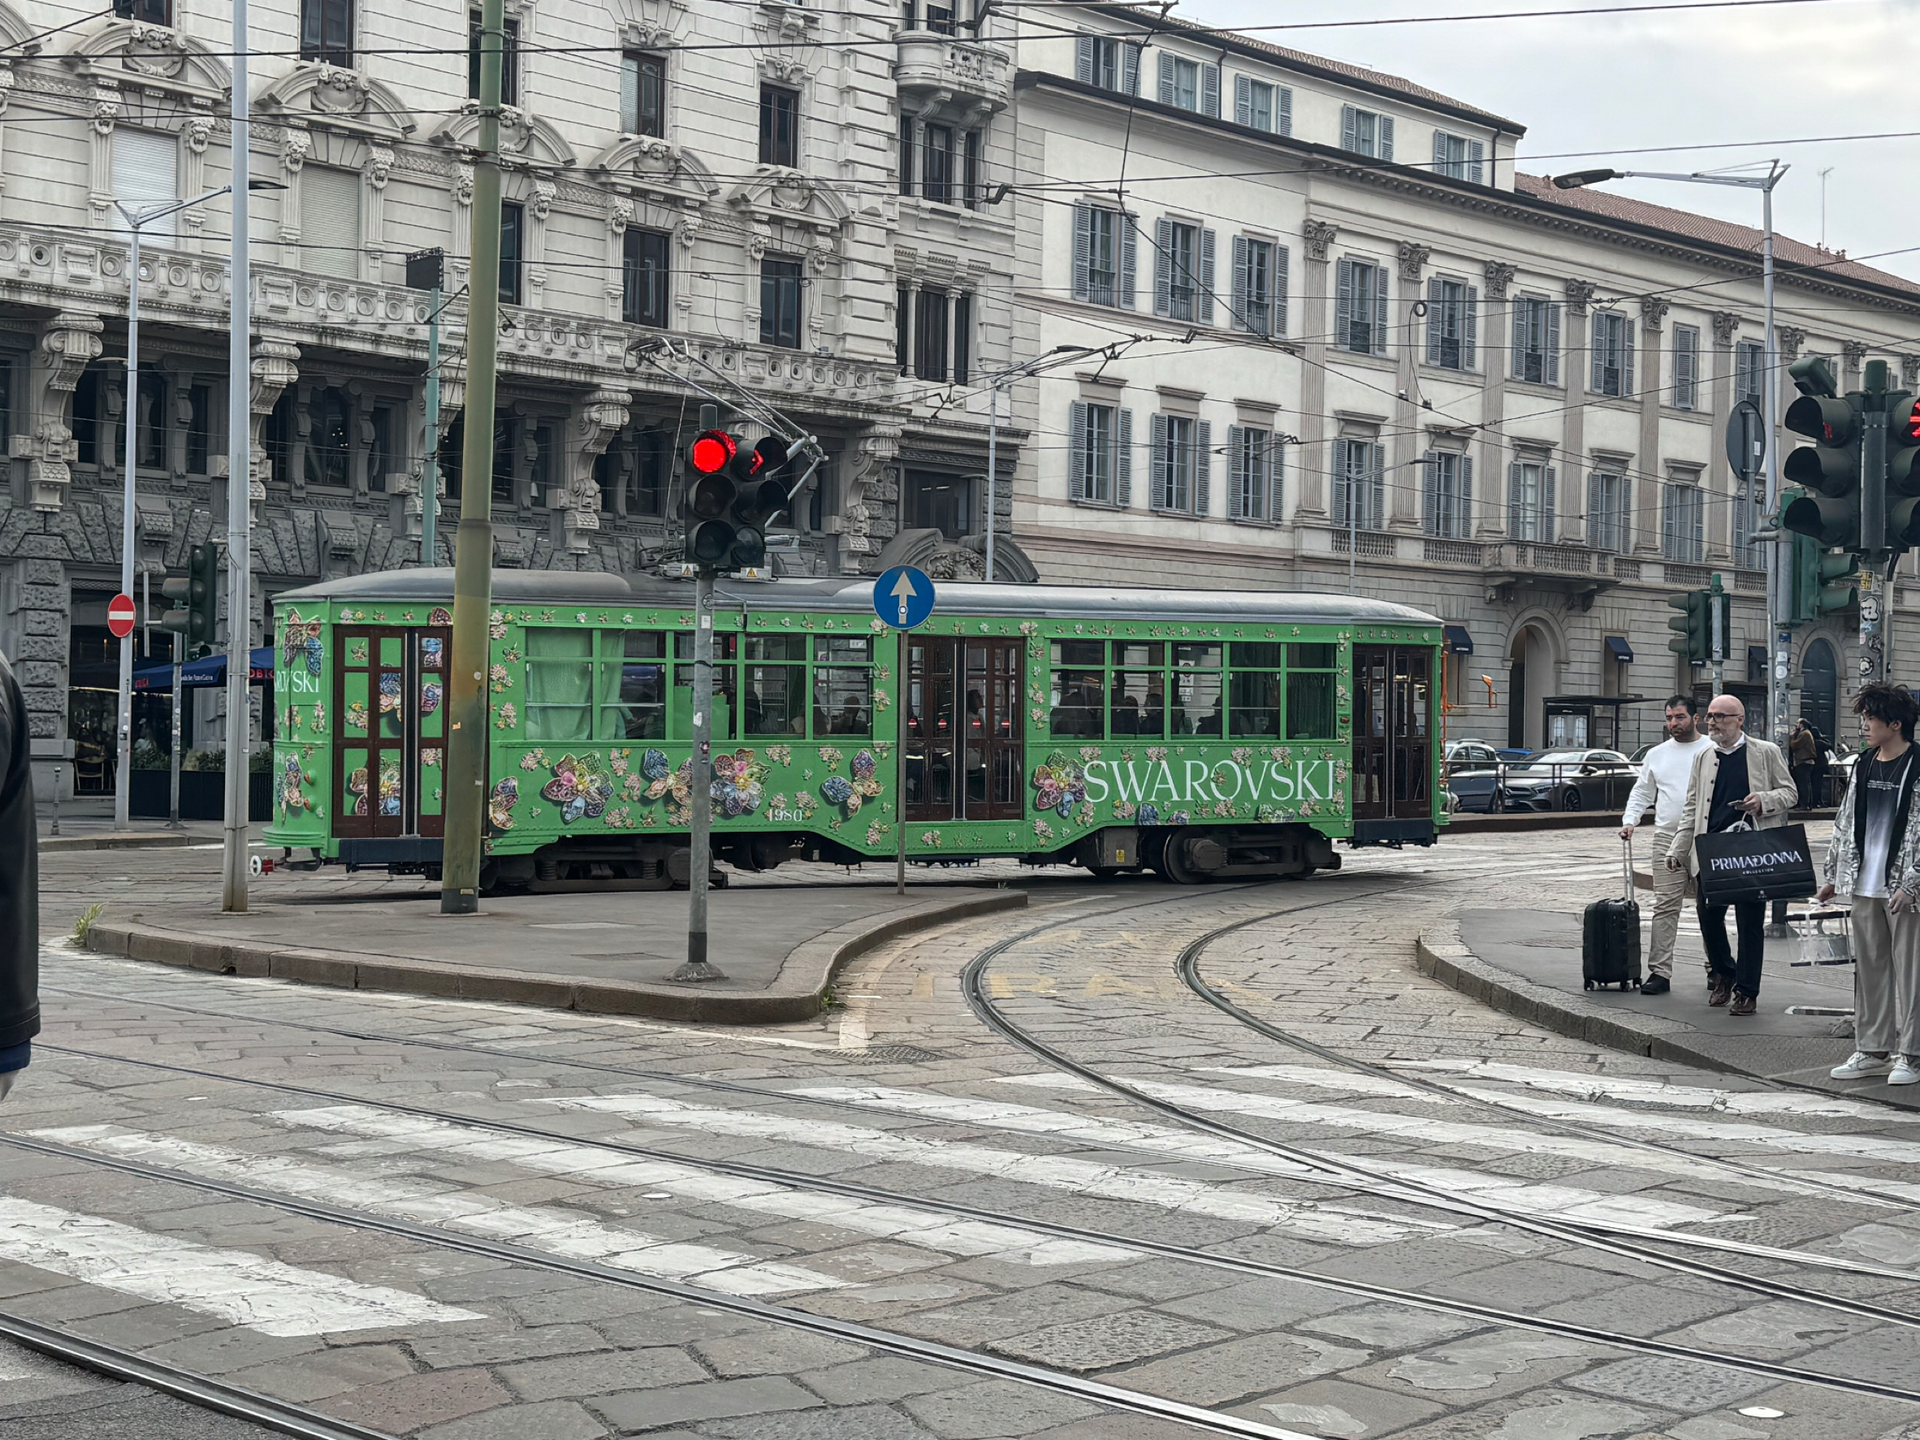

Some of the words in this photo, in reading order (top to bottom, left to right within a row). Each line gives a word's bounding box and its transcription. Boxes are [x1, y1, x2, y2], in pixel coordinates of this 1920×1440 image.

[1083, 759, 1336, 803] SWAROVSKI
[769, 808, 803, 822] 1980
[1710, 850, 1803, 871] PRIMADONNA
